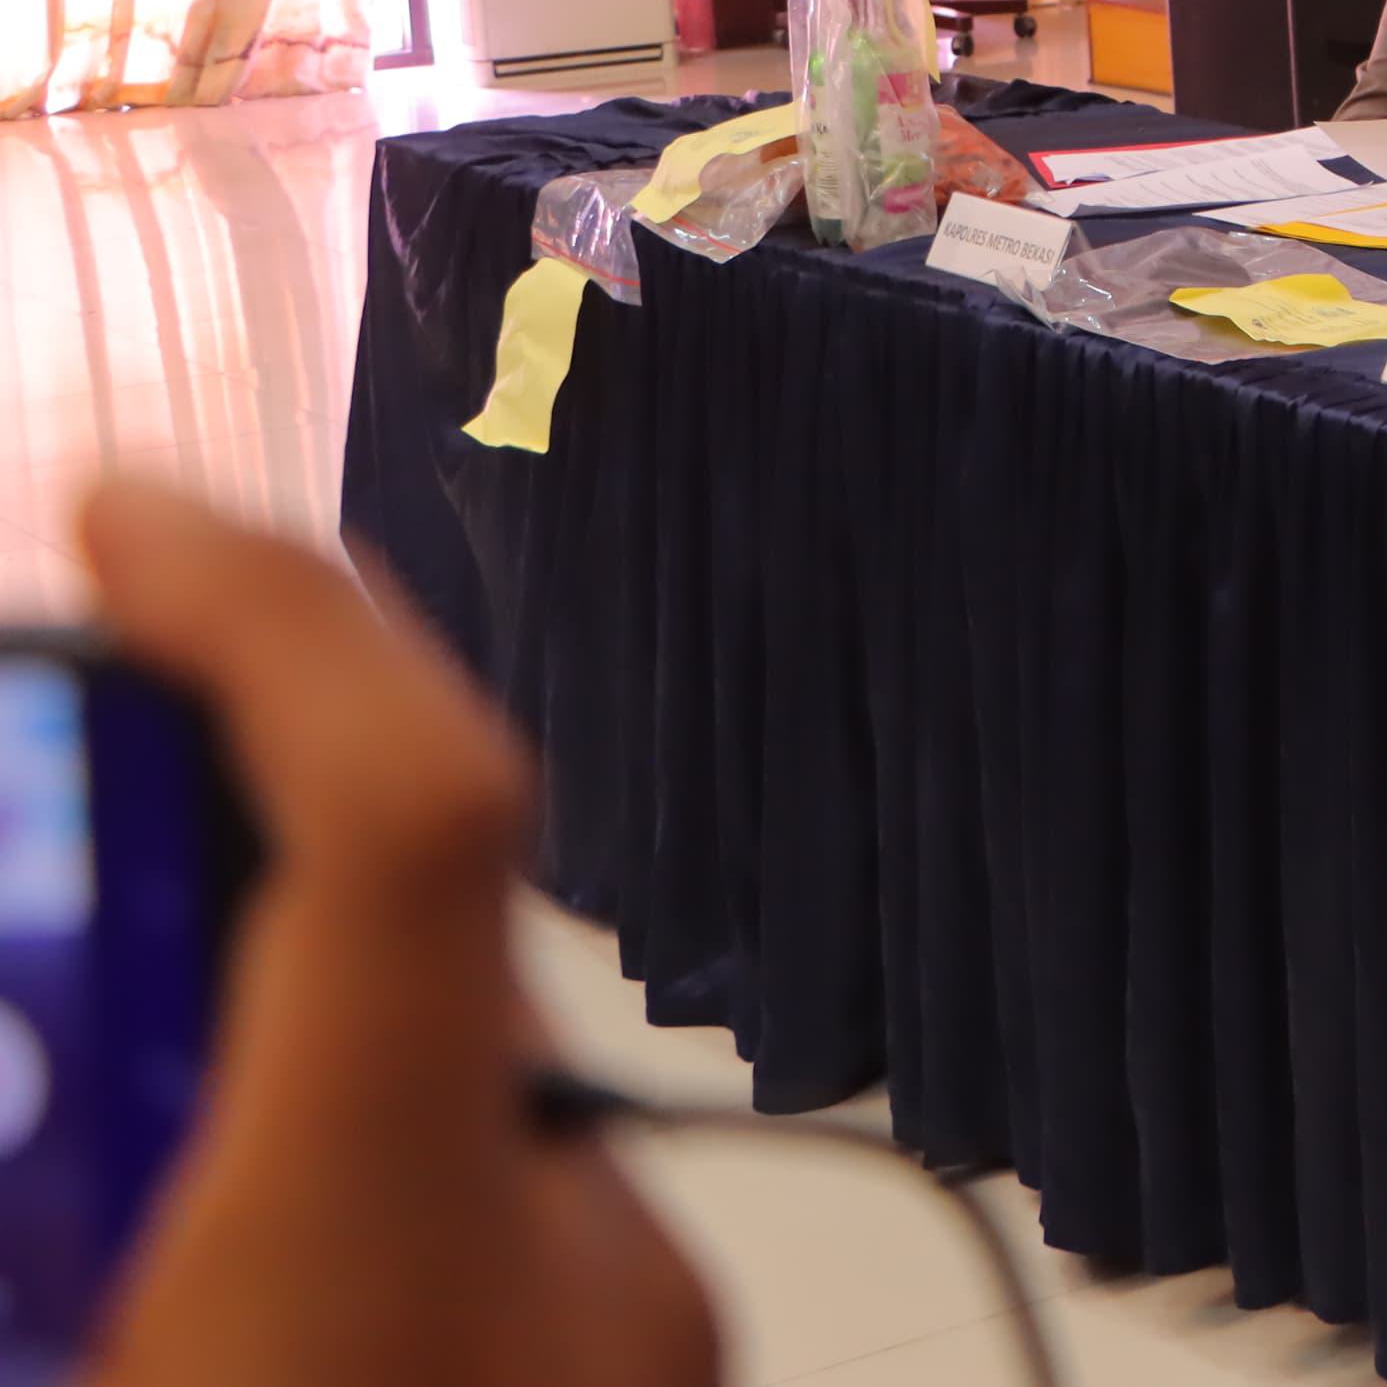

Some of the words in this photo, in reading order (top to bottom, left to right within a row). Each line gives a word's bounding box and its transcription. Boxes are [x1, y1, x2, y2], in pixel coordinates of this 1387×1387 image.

[944, 221, 986, 247] KAPOLRES
[986, 233, 1021, 255] METRO
[1020, 242, 1056, 265] BEKASI
